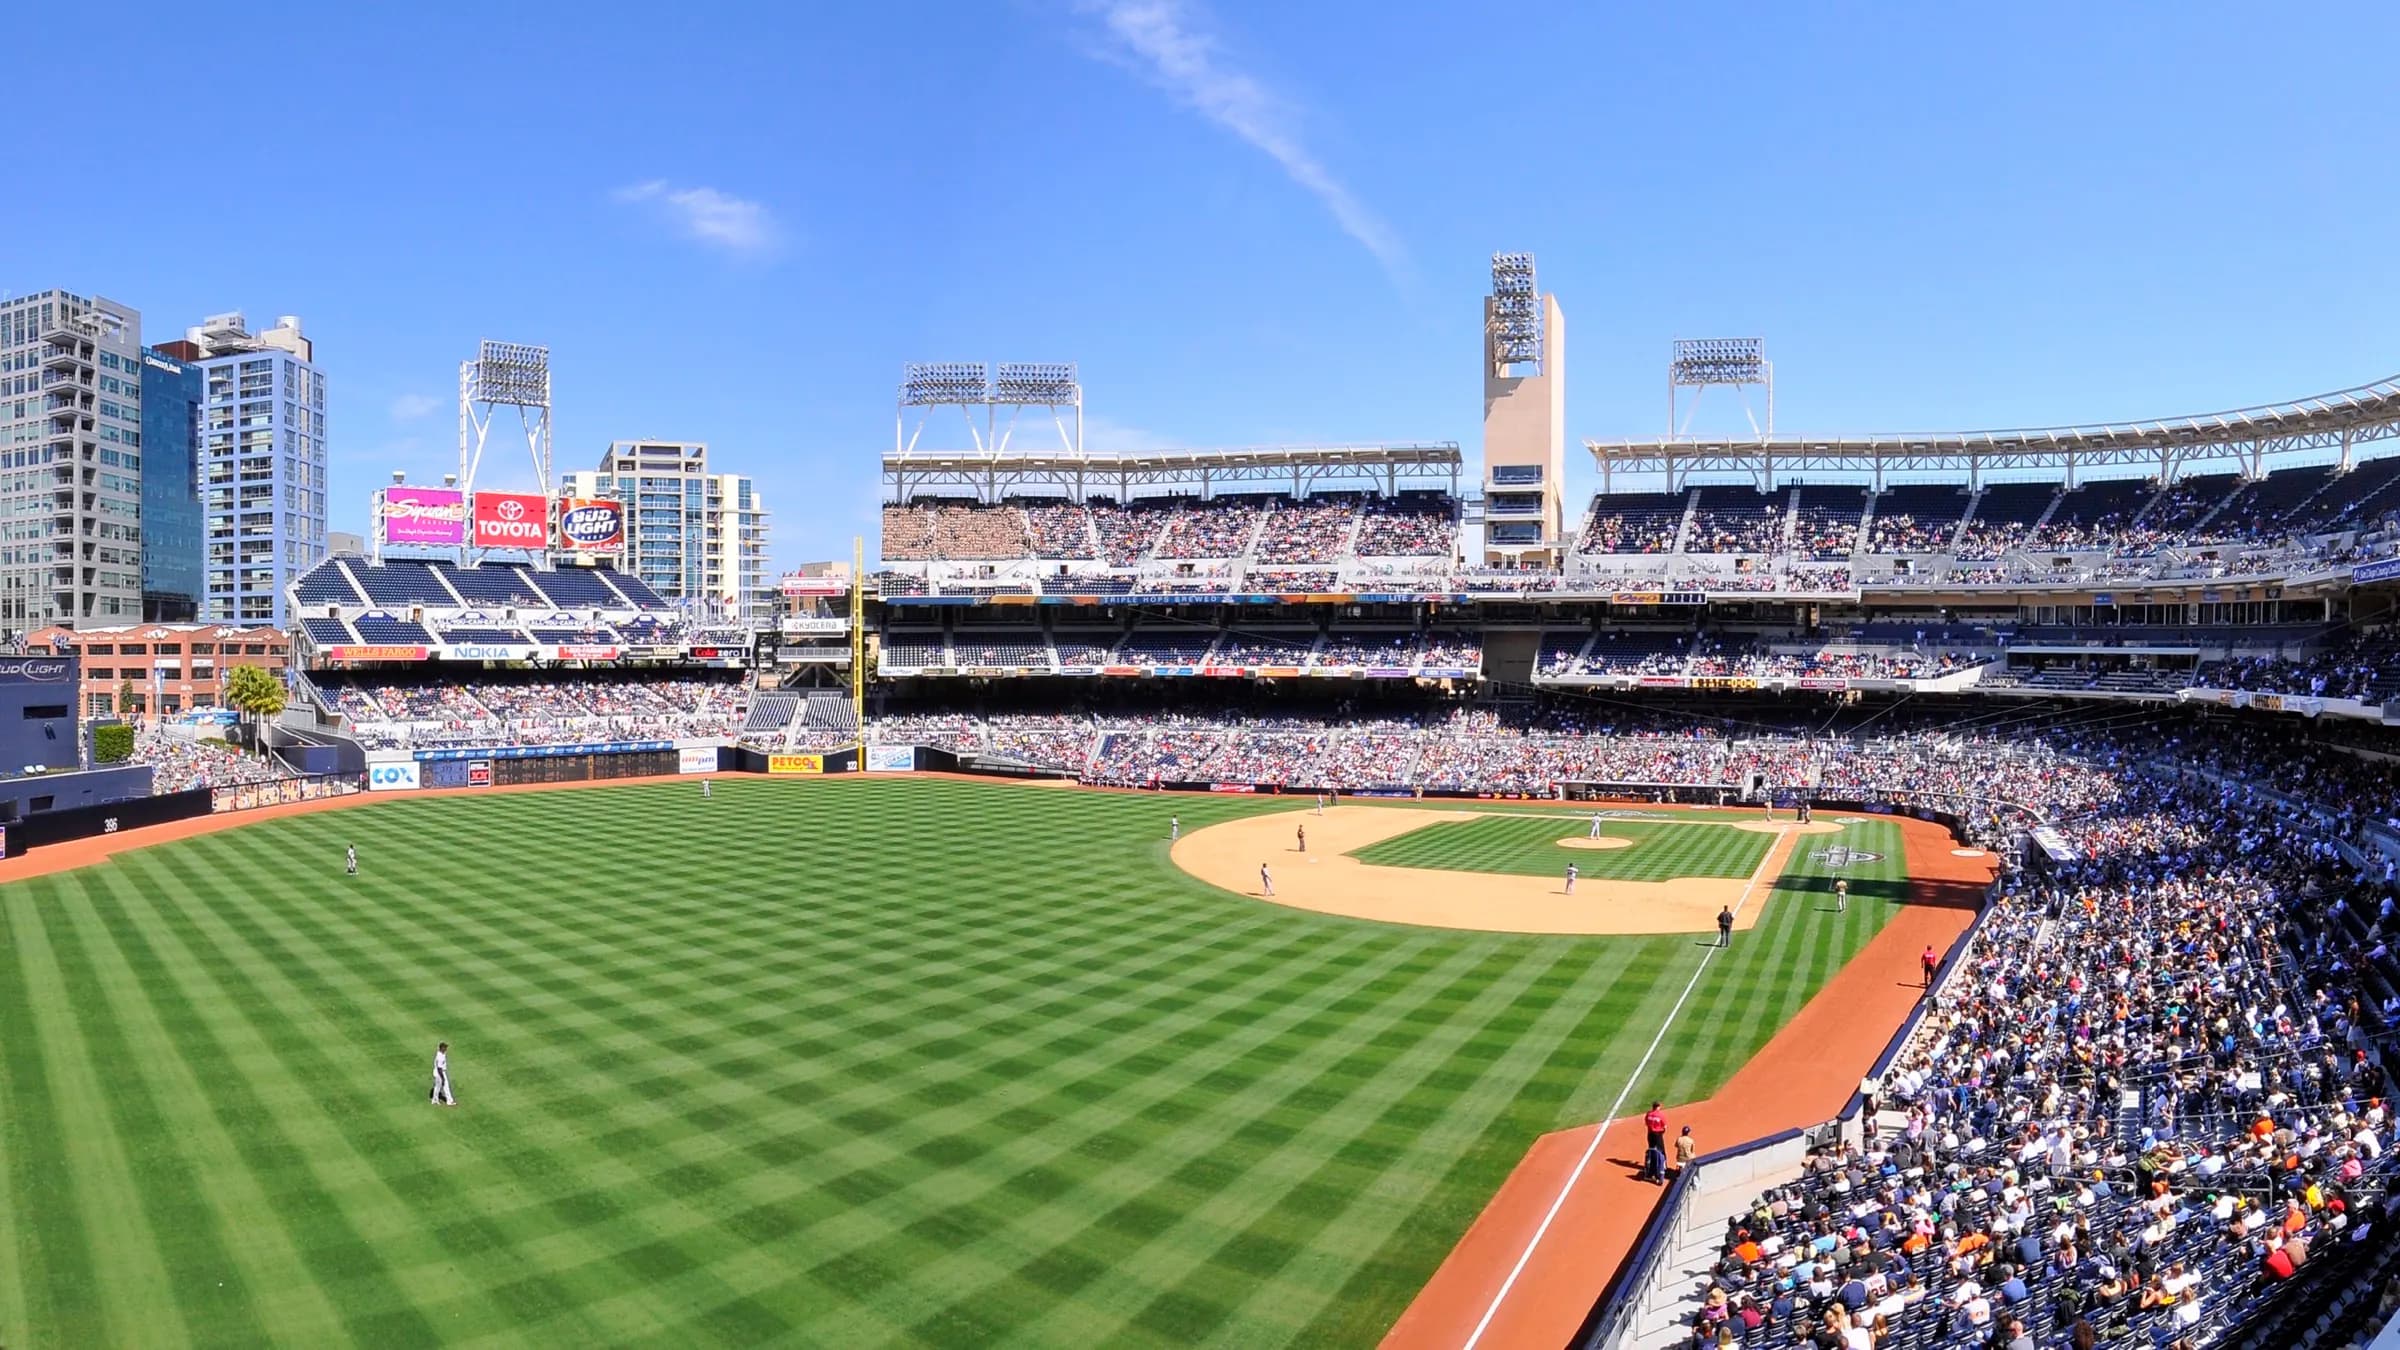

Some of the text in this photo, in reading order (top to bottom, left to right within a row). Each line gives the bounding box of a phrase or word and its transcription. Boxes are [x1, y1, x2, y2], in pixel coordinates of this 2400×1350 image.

[572, 509, 612, 523] BUD
[478, 520, 543, 538] TOYOTA
[567, 520, 617, 534] LIGHT
[343, 647, 416, 656] WELLS FARGO
[454, 647, 509, 658] NOKIA
[695, 647, 740, 657] Coke zero
[27, 664, 65, 674] LIGHT
[682, 754, 715, 765] ampm
[772, 757, 811, 766] PETCO
[372, 767, 414, 784] COX
[104, 818, 118, 832] 396
